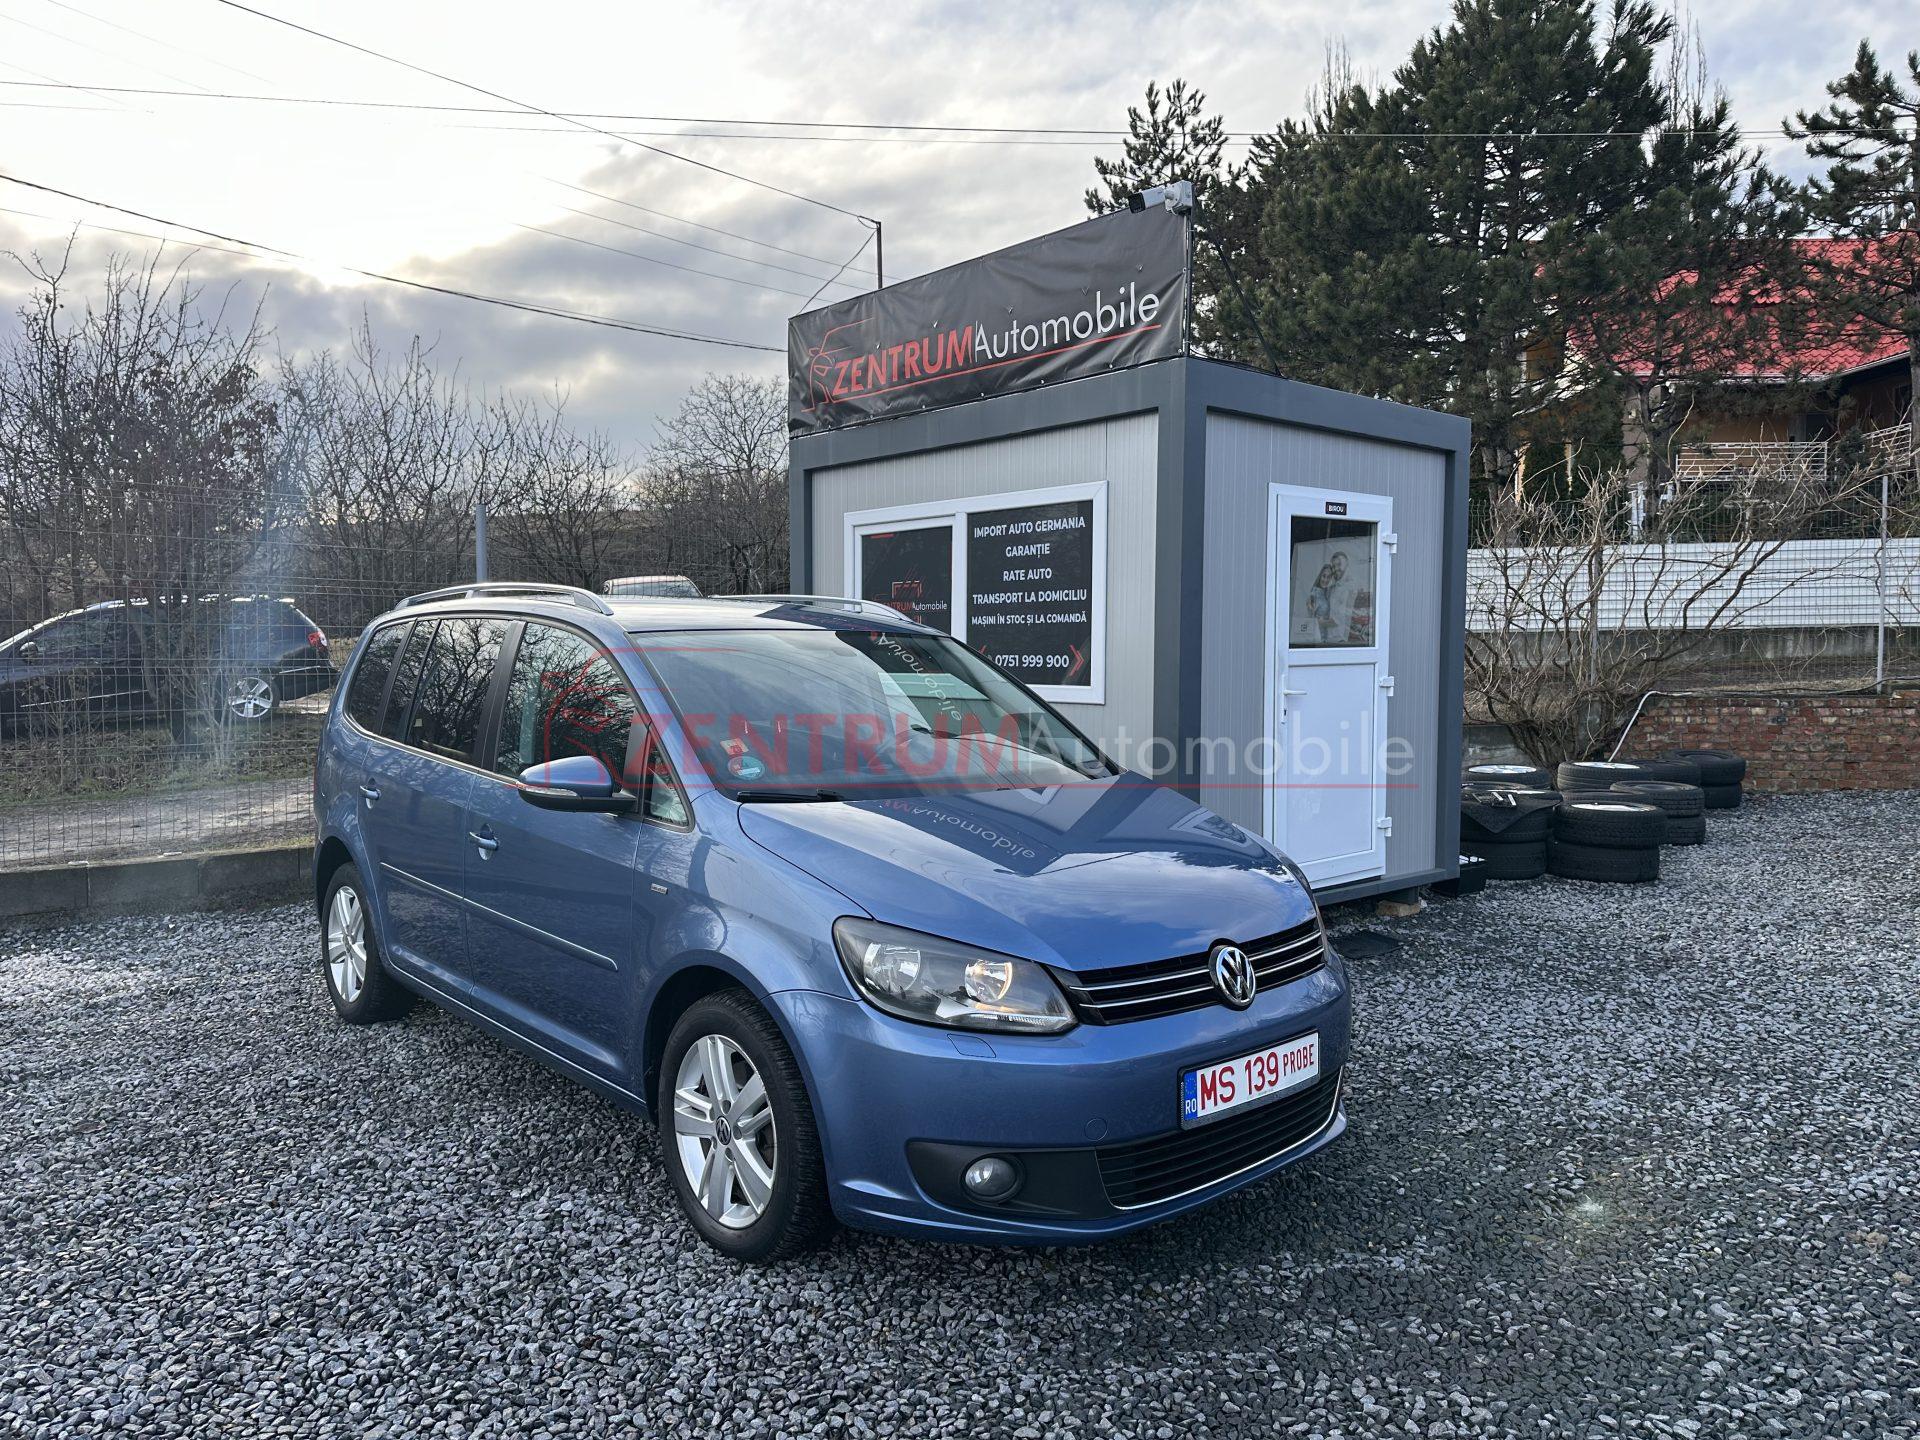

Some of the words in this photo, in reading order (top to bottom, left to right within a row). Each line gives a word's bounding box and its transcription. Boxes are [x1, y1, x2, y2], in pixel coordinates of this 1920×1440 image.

[974, 524, 1007, 538] IMPORT
[1008, 521, 1033, 535] AUTO
[1035, 516, 1086, 532] GERMANIA
[1005, 542, 1050, 558] GARANȚIE
[1003, 569, 1026, 581] RATE
[1027, 567, 1052, 580] AUTO
[972, 592, 1023, 605] TRANSPORT
[1024, 591, 1037, 603] LA
[1038, 589, 1087, 602] DOMICILIU
[971, 615, 996, 627] MAȘINI
[997, 613, 1005, 625] ÎN
[1006, 614, 1025, 625] STOC
[1026, 614, 1034, 626] ȘI
[1035, 614, 1045, 624] LA
[1046, 610, 1087, 624] COMANDĂ
[995, 654, 1019, 667] 0751
[1021, 654, 1043, 667] 999
[1046, 654, 1070, 668] 900
[1200, 1065, 1236, 1110] MS
[1244, 1051, 1279, 1095] 139
[1282, 1043, 1315, 1077] PROBE
[1185, 1098, 1197, 1115] RO
